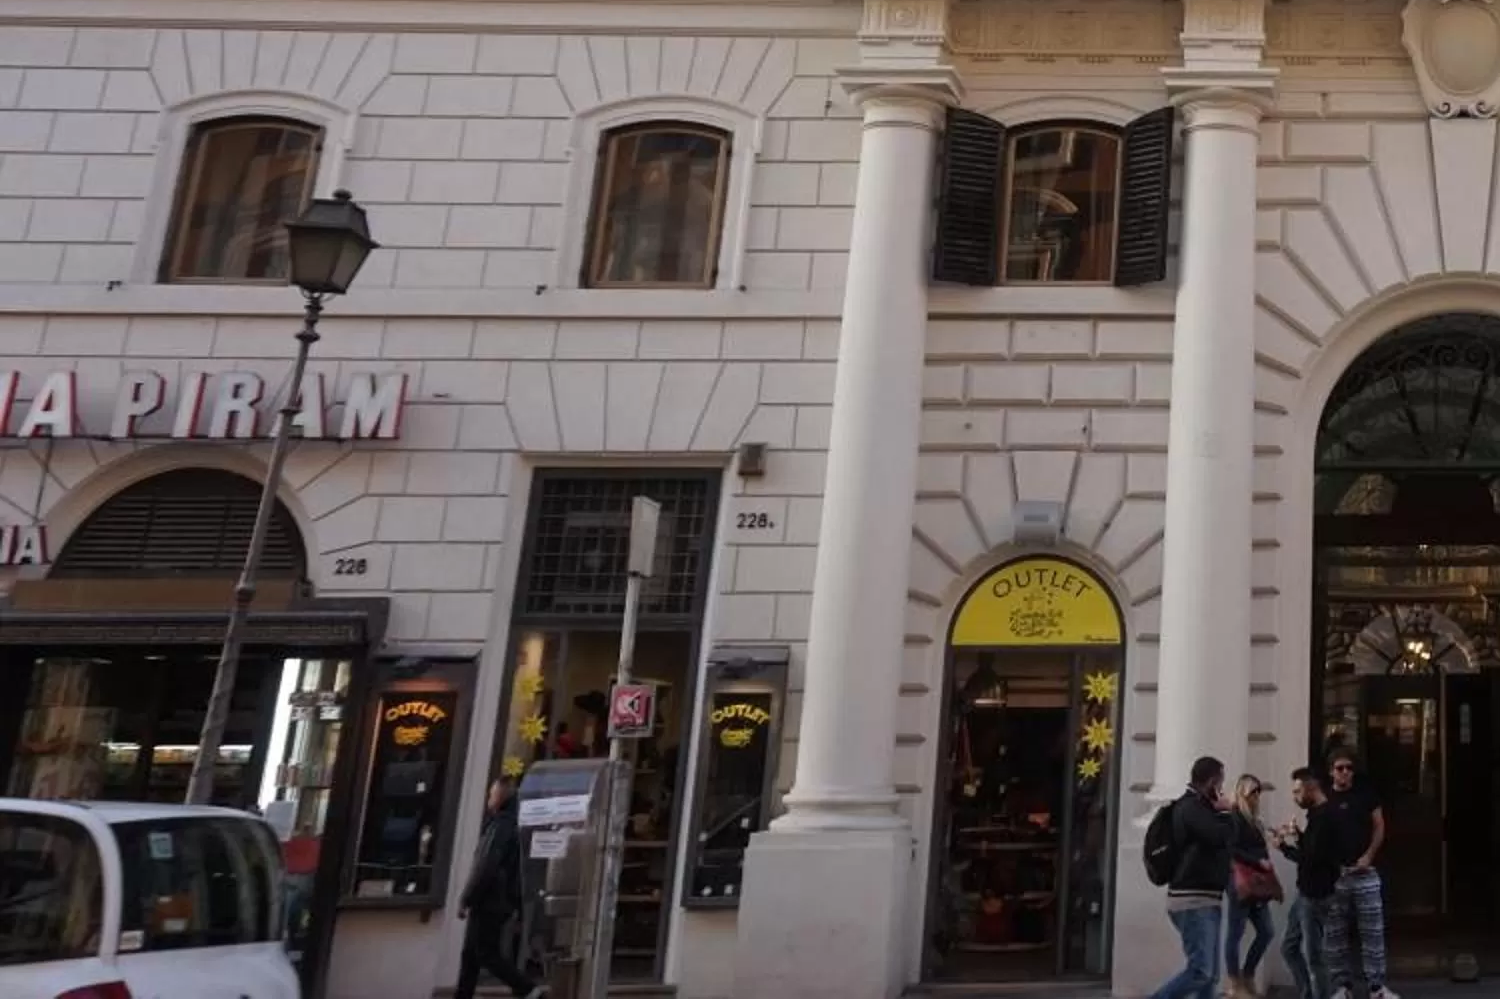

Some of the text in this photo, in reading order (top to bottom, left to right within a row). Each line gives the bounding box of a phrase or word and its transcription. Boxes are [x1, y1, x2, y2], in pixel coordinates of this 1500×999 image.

[110, 370, 408, 440] PIRAM
[992, 568, 1092, 599] OUTLET
[385, 701, 447, 723] OUTLET
[711, 704, 771, 725] OUTLET
